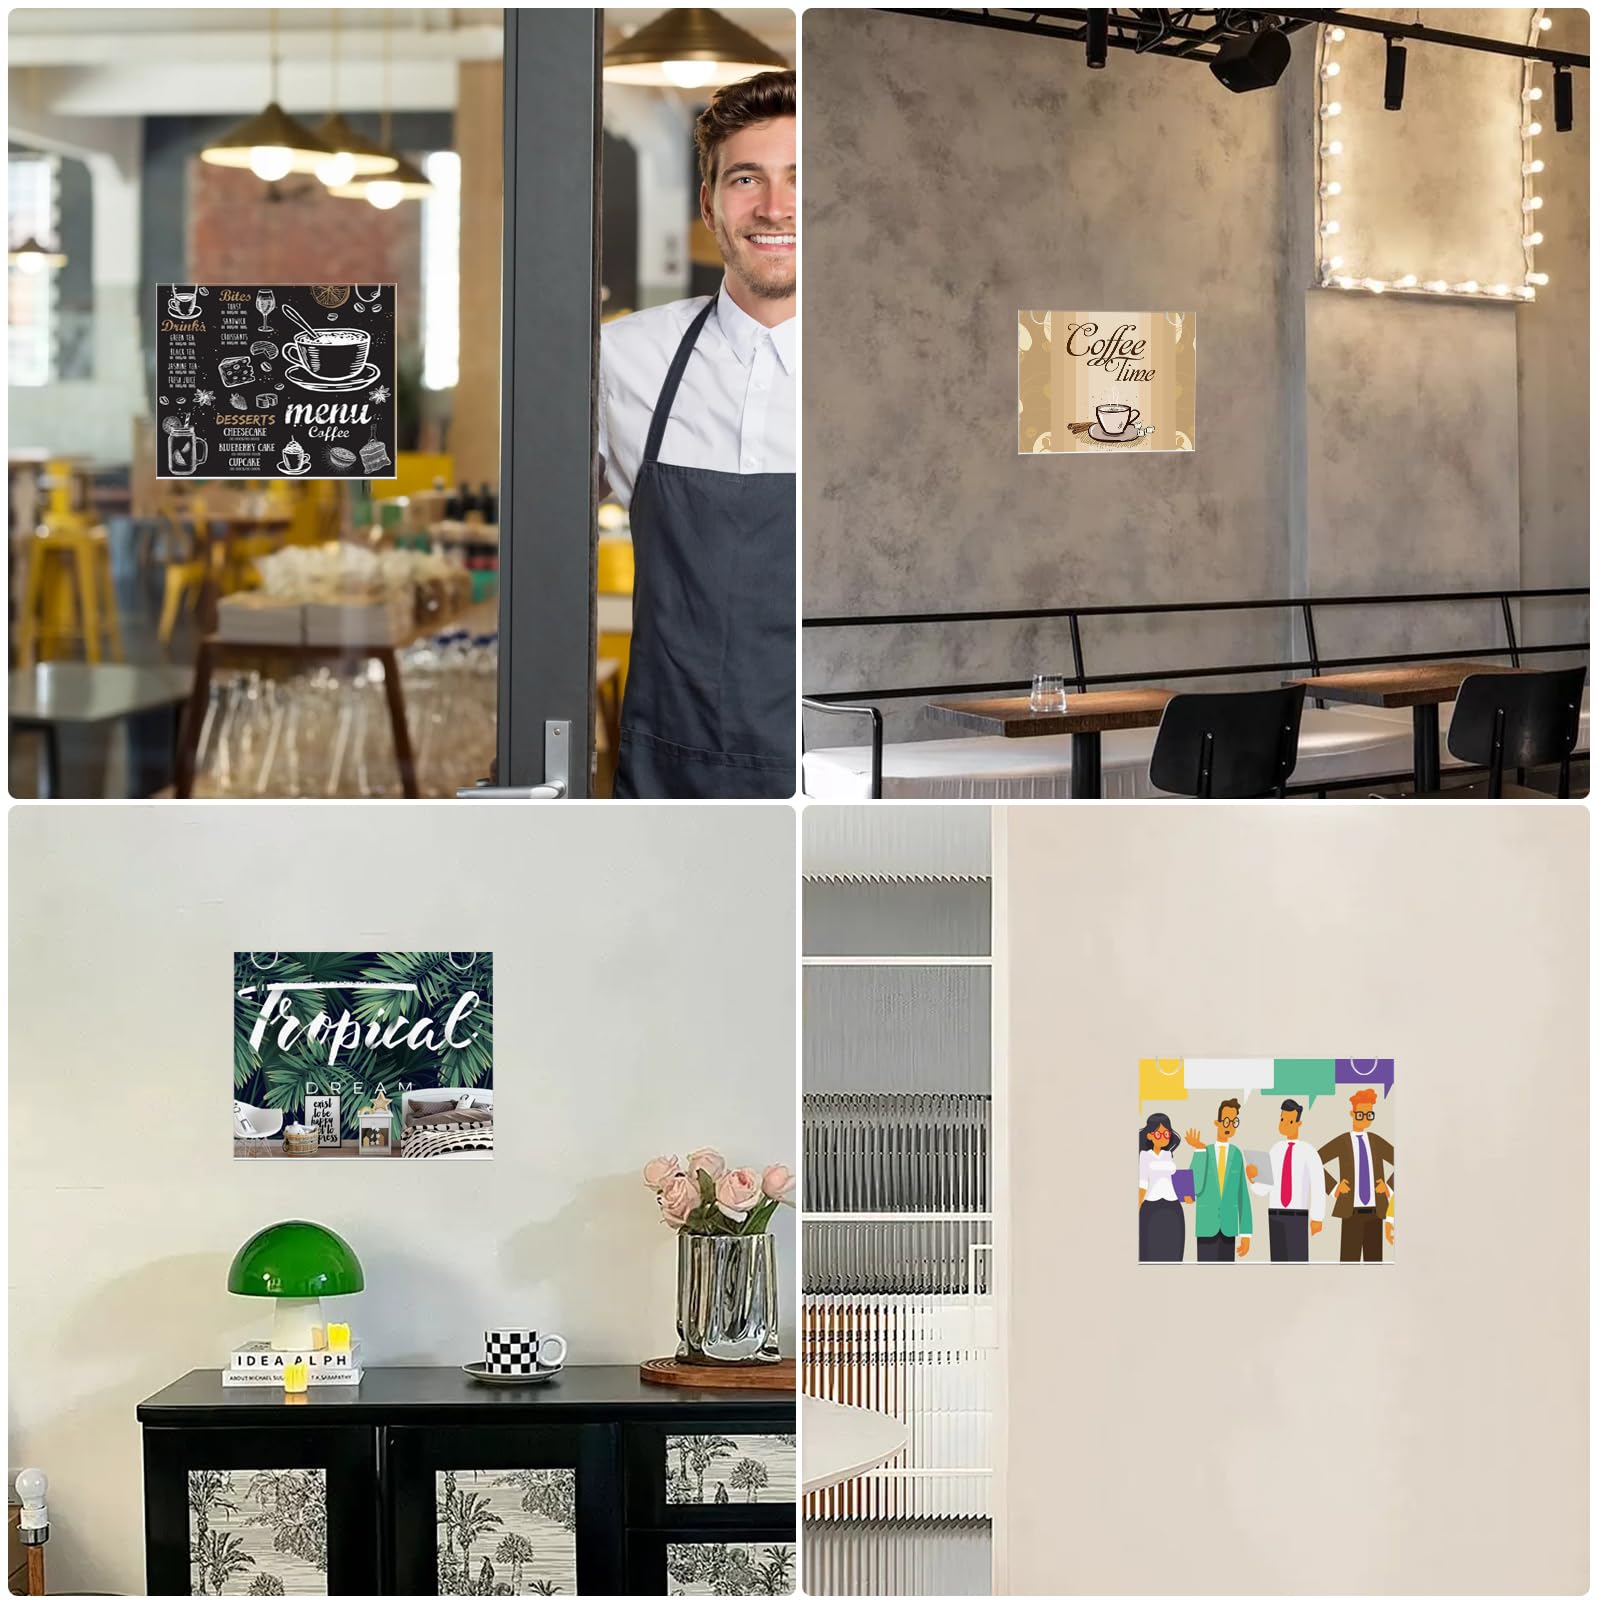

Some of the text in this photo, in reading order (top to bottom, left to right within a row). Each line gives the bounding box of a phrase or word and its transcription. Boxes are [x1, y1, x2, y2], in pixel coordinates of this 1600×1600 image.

[218, 289, 251, 302] Bites
[161, 320, 206, 332] Drinks
[1066, 322, 1146, 366] Coffee
[1104, 356, 1155, 381] Time
[216, 414, 276, 426] DESSERTS
[285, 403, 372, 425] menu
[223, 427, 267, 437] CHEESECAKE
[308, 425, 350, 441] Coffee
[218, 443, 275, 452] BLUEBERRY CAKE
[228, 457, 261, 467] CUPCAKE
[237, 981, 480, 1066] Tropical
[306, 1082, 413, 1095] DREAM
[313, 1098, 333, 1109] exist
[313, 1108, 332, 1118] to be
[311, 1115, 334, 1127] happy
[326, 1124, 334, 1134] to
[237, 1355, 347, 1366] IDEA ALPH
